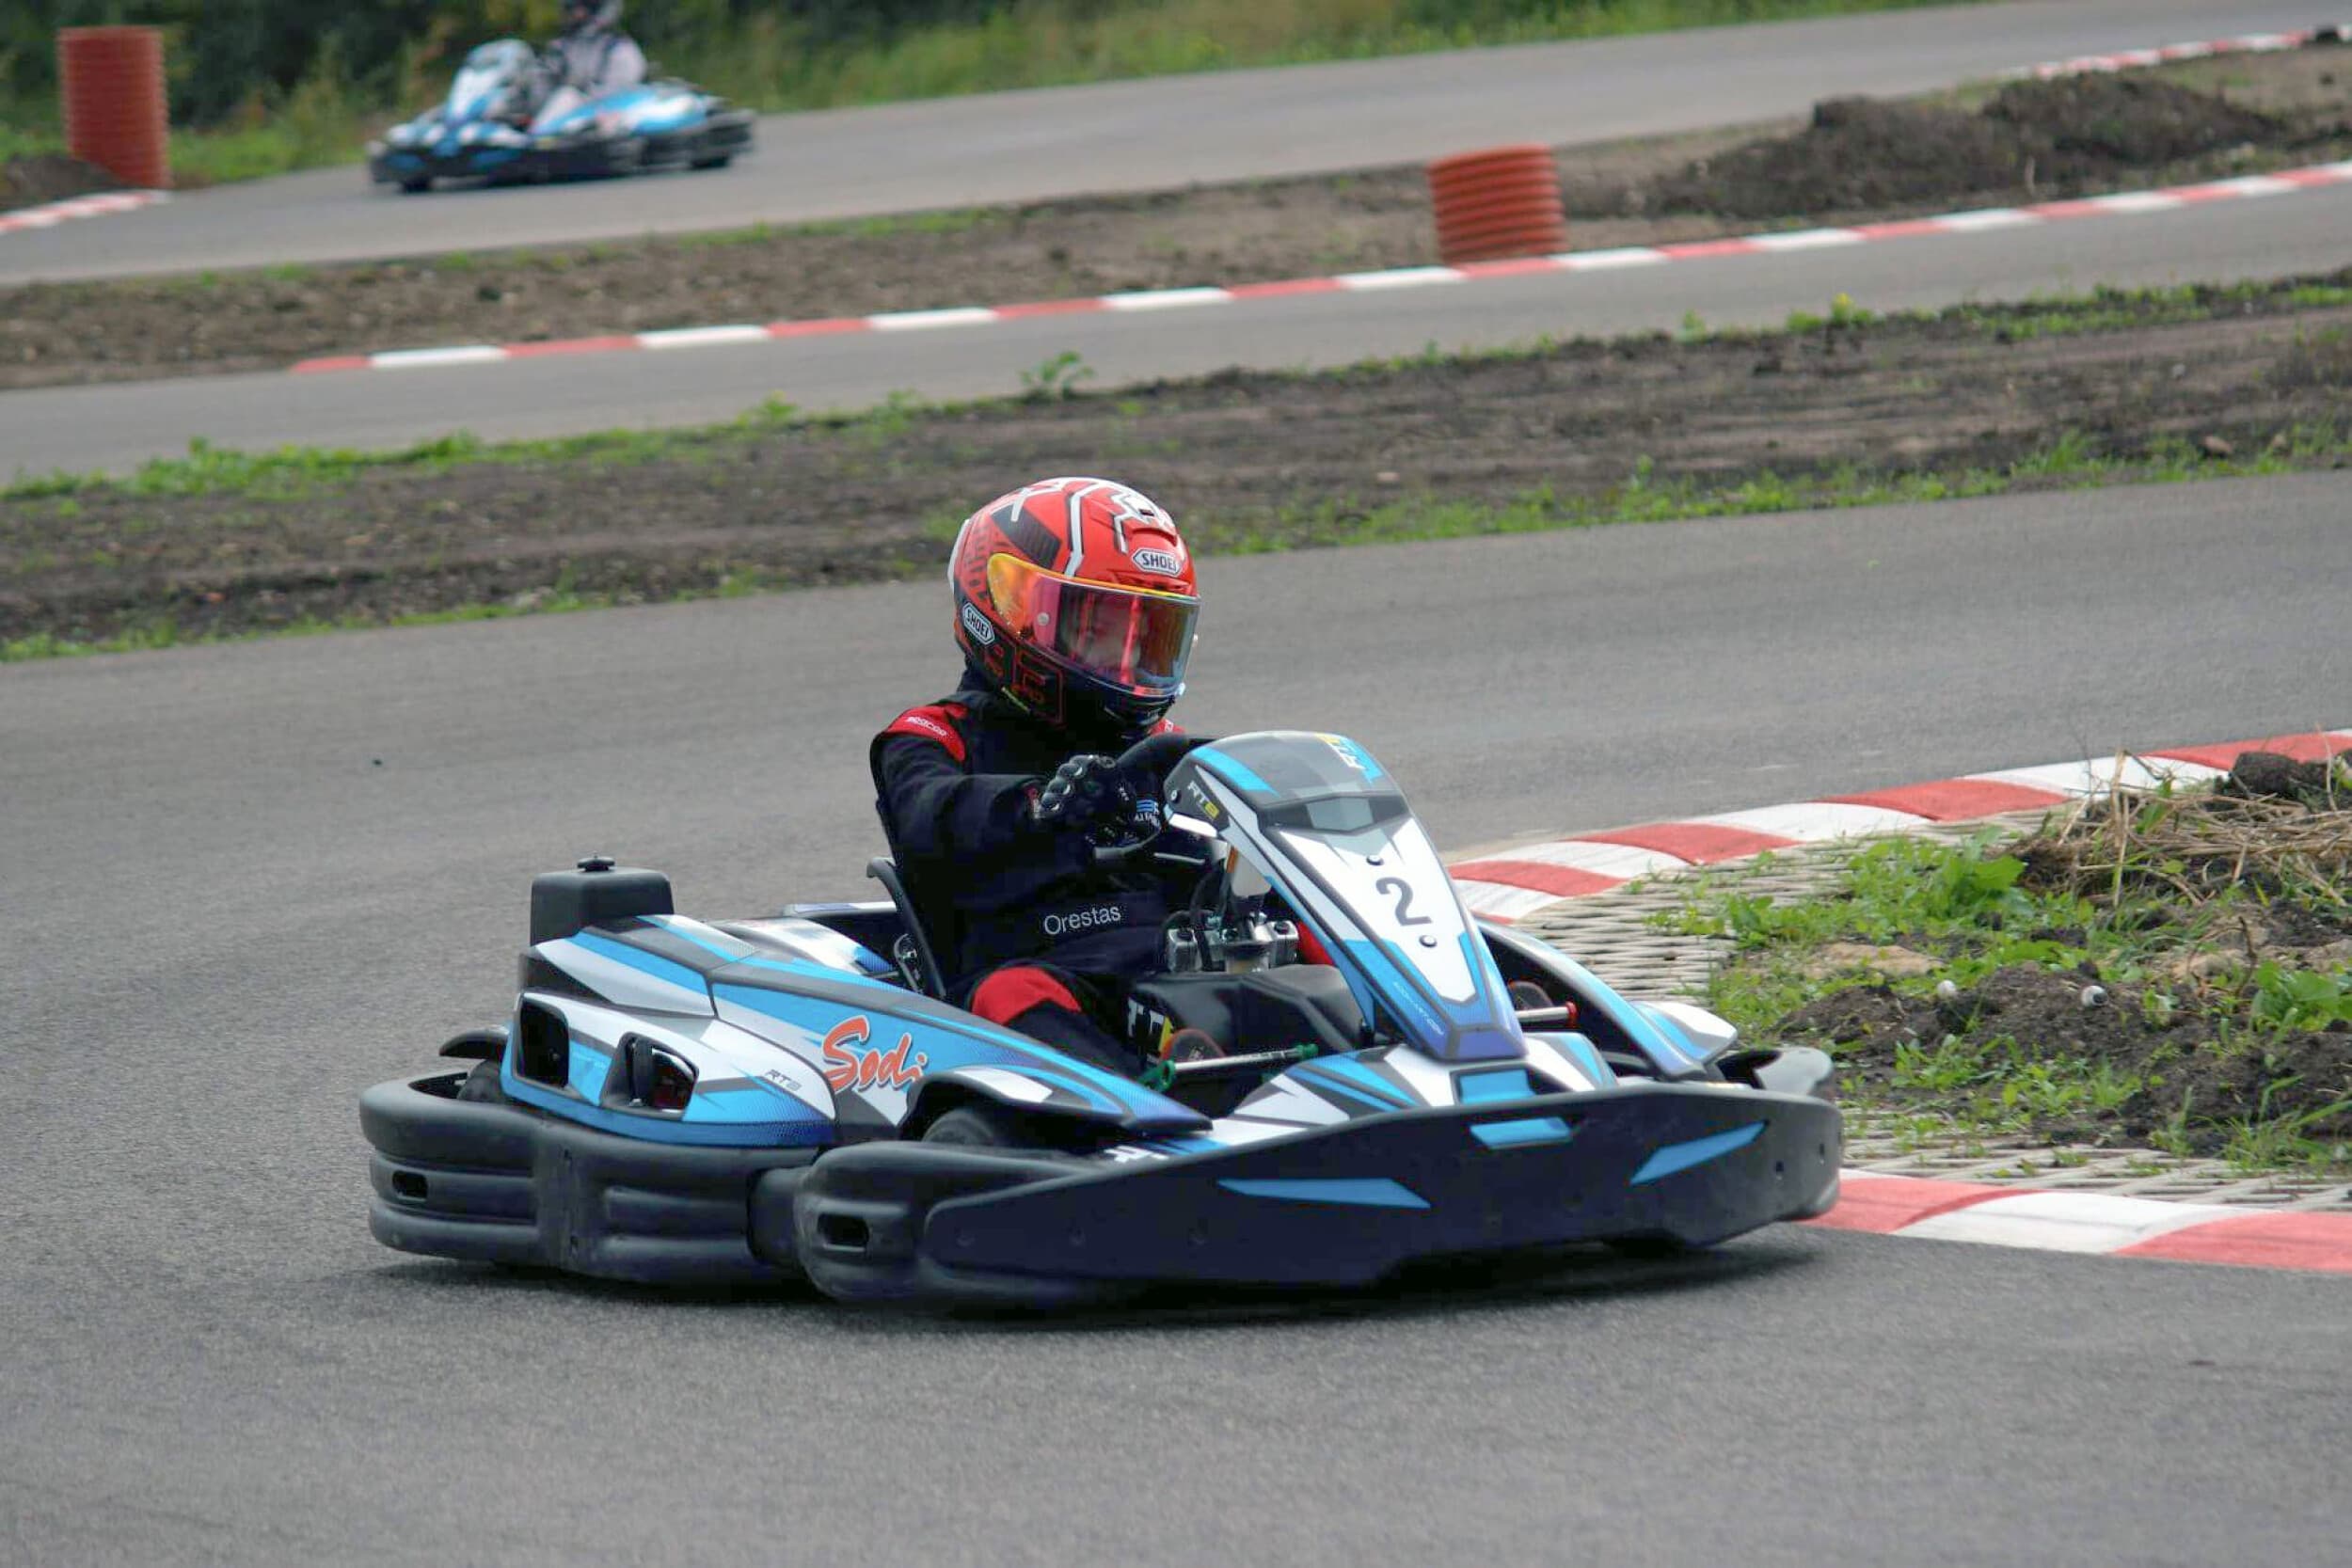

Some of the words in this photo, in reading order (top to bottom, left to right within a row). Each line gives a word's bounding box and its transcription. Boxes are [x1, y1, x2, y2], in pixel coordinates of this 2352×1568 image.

[1141, 552, 1177, 572] SHOEI
[966, 609, 990, 639] SHOEI
[1375, 877, 1432, 927] 2
[1044, 906, 1121, 935] Orestas
[822, 1015, 927, 1094] Sodi
